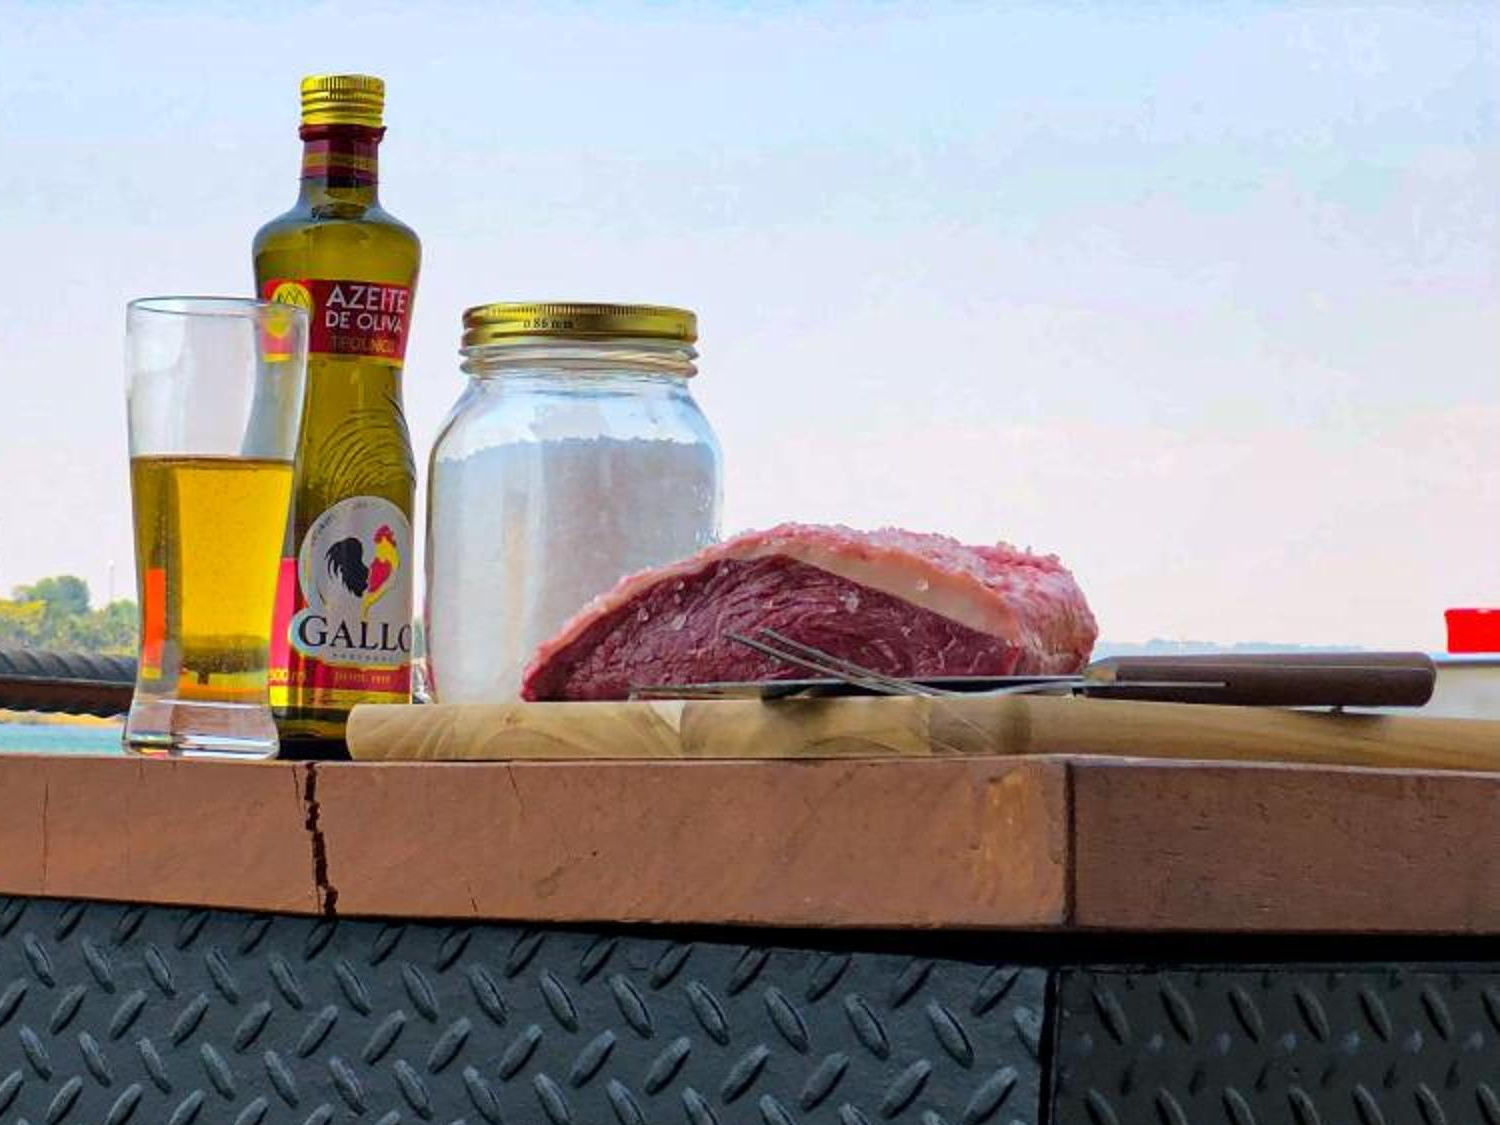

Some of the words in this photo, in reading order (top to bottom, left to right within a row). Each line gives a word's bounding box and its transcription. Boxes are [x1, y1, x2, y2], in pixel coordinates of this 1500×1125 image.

[325, 284, 408, 313] AZEITE
[325, 310, 351, 329] DE
[357, 312, 403, 333] OLIVA
